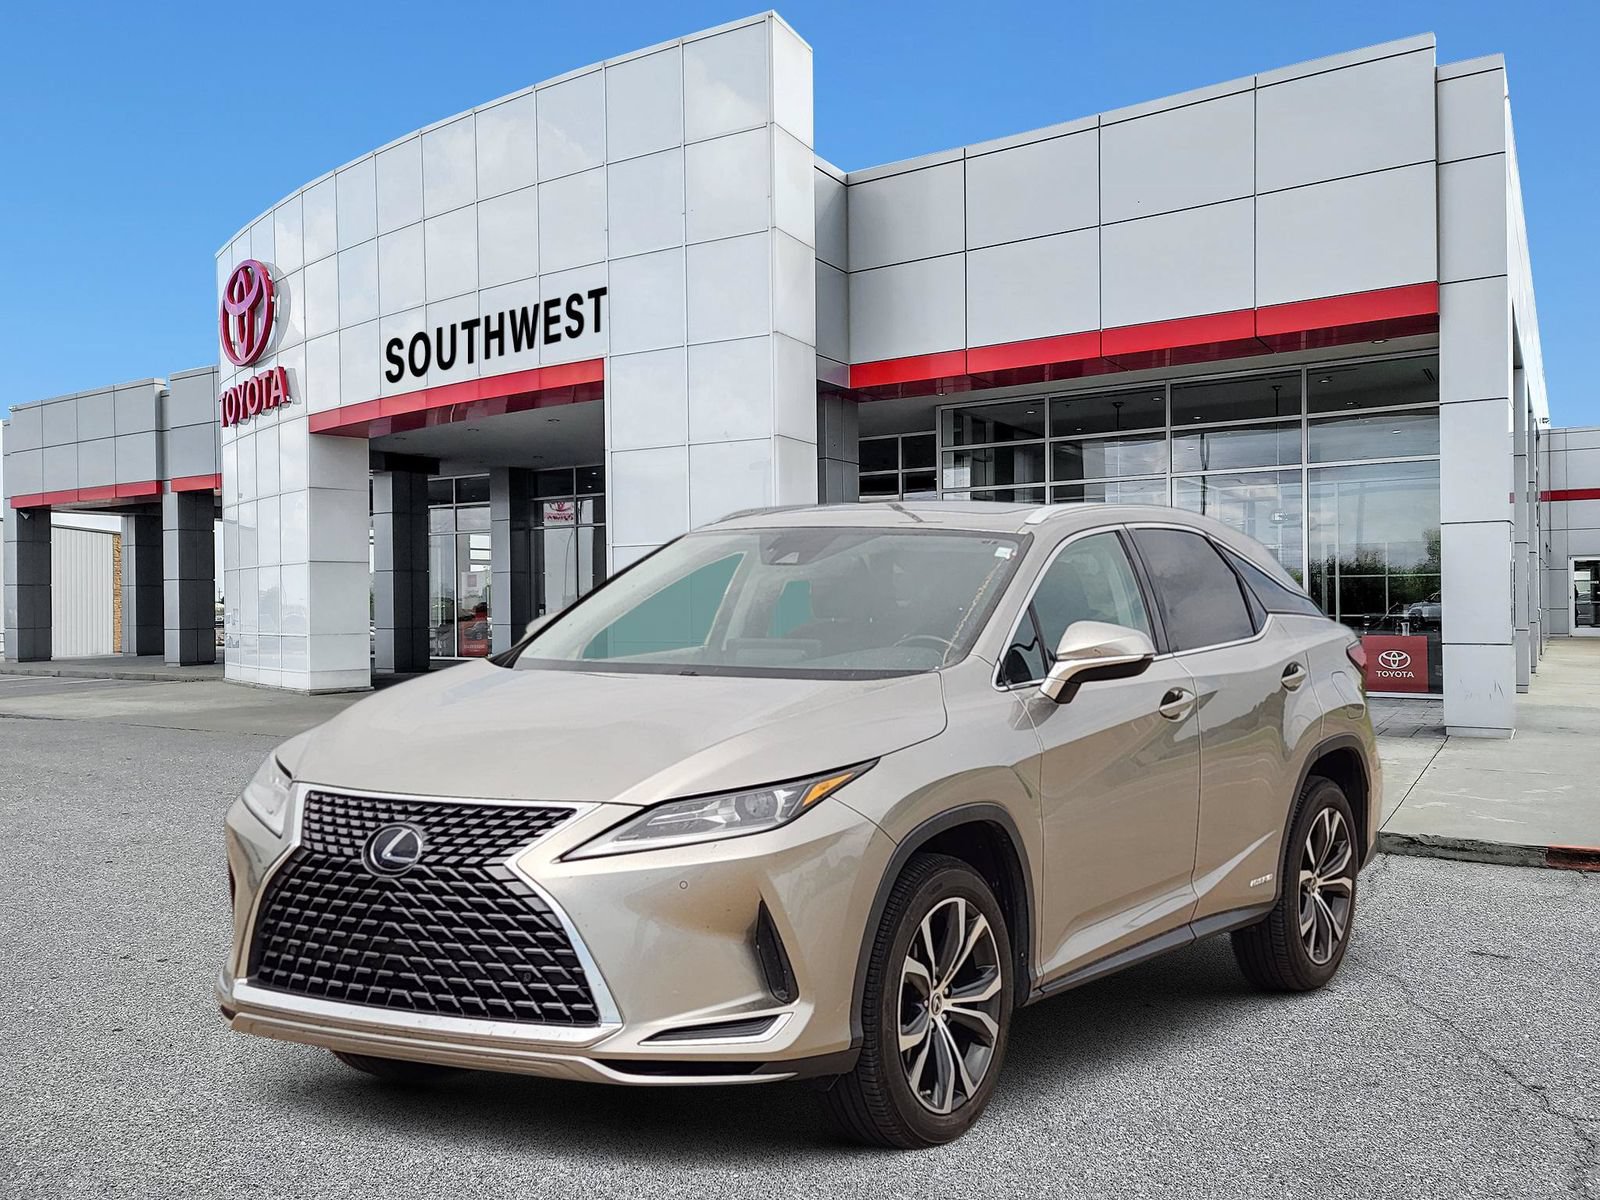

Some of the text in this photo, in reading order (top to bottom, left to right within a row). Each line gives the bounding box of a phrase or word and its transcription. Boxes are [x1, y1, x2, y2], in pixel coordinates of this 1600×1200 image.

[385, 286, 607, 384] SOUTHWEST
[219, 366, 291, 428] TOYOTA
[1376, 670, 1414, 678] TOYOTA
